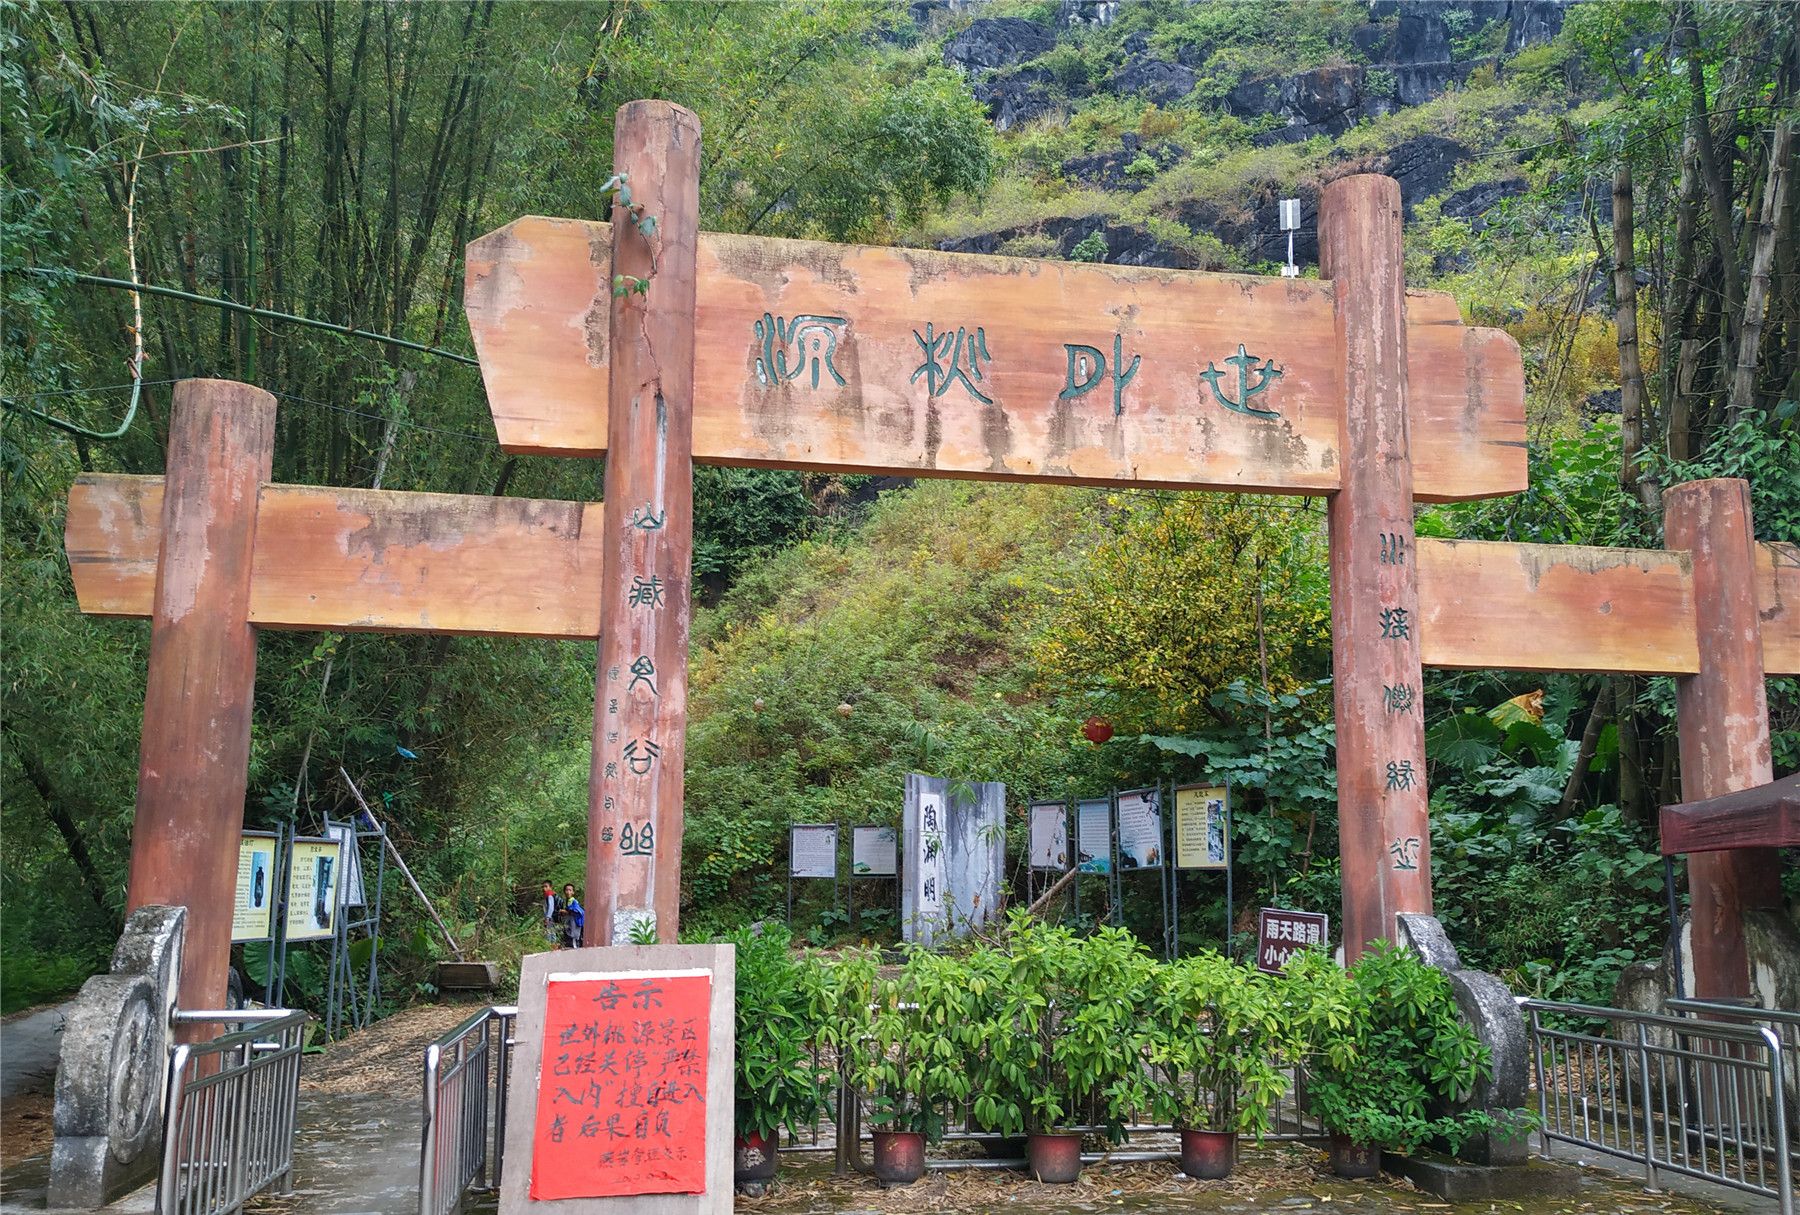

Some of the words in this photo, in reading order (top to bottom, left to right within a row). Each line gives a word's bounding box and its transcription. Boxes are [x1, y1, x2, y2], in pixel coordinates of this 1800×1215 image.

[1266, 918, 1320, 944] 雨天路滑
[592, 980, 663, 1010] 告示
